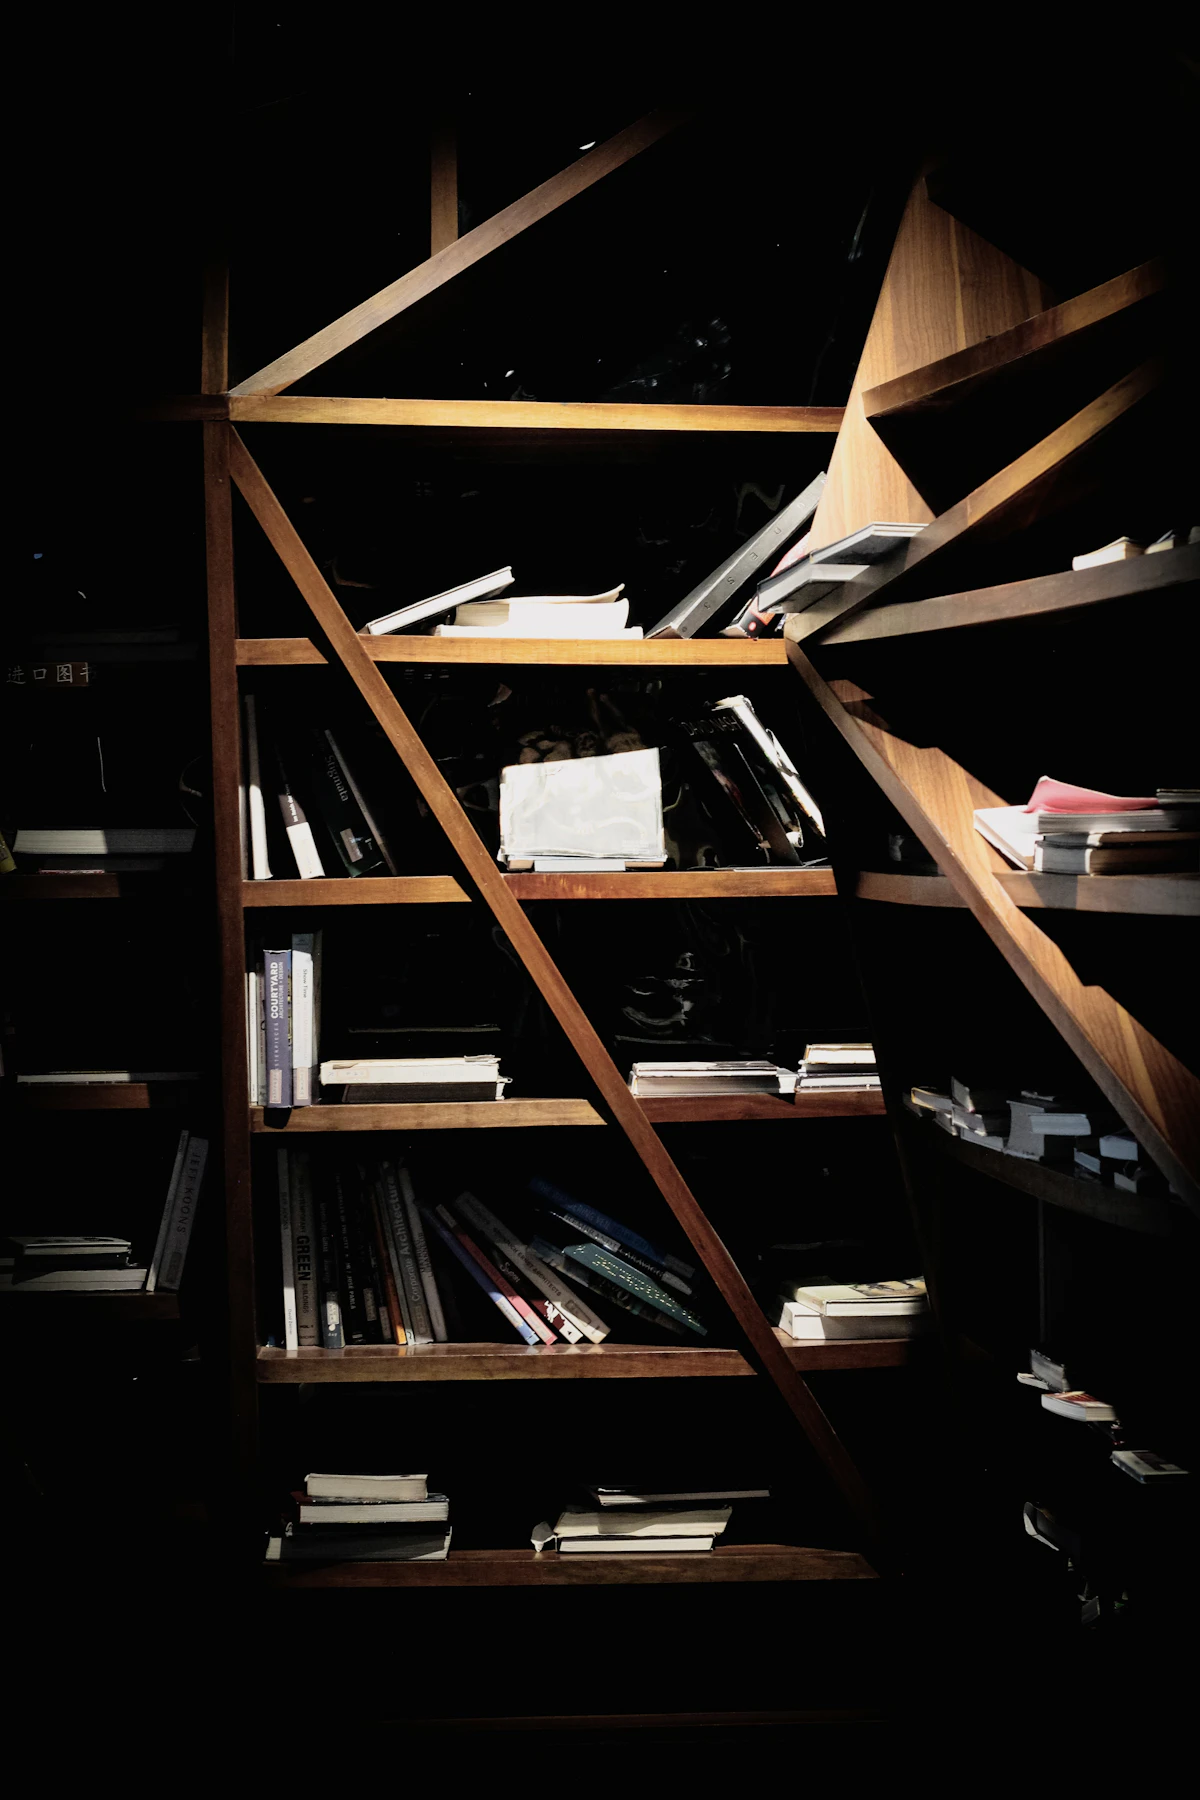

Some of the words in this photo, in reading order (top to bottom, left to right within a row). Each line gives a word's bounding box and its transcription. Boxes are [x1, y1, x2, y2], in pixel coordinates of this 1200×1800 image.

[325, 754, 349, 801] Stigmata
[271, 962, 279, 1018] COURTYARD
[188, 1152, 200, 1181] JEFF
[177, 1187, 193, 1233] KOONS
[387, 1174, 411, 1255] Architecture
[295, 1235, 311, 1280] GREEN
[405, 1257, 421, 1302] Corporate
[531, 1266, 562, 1297] ARCHITECTS
